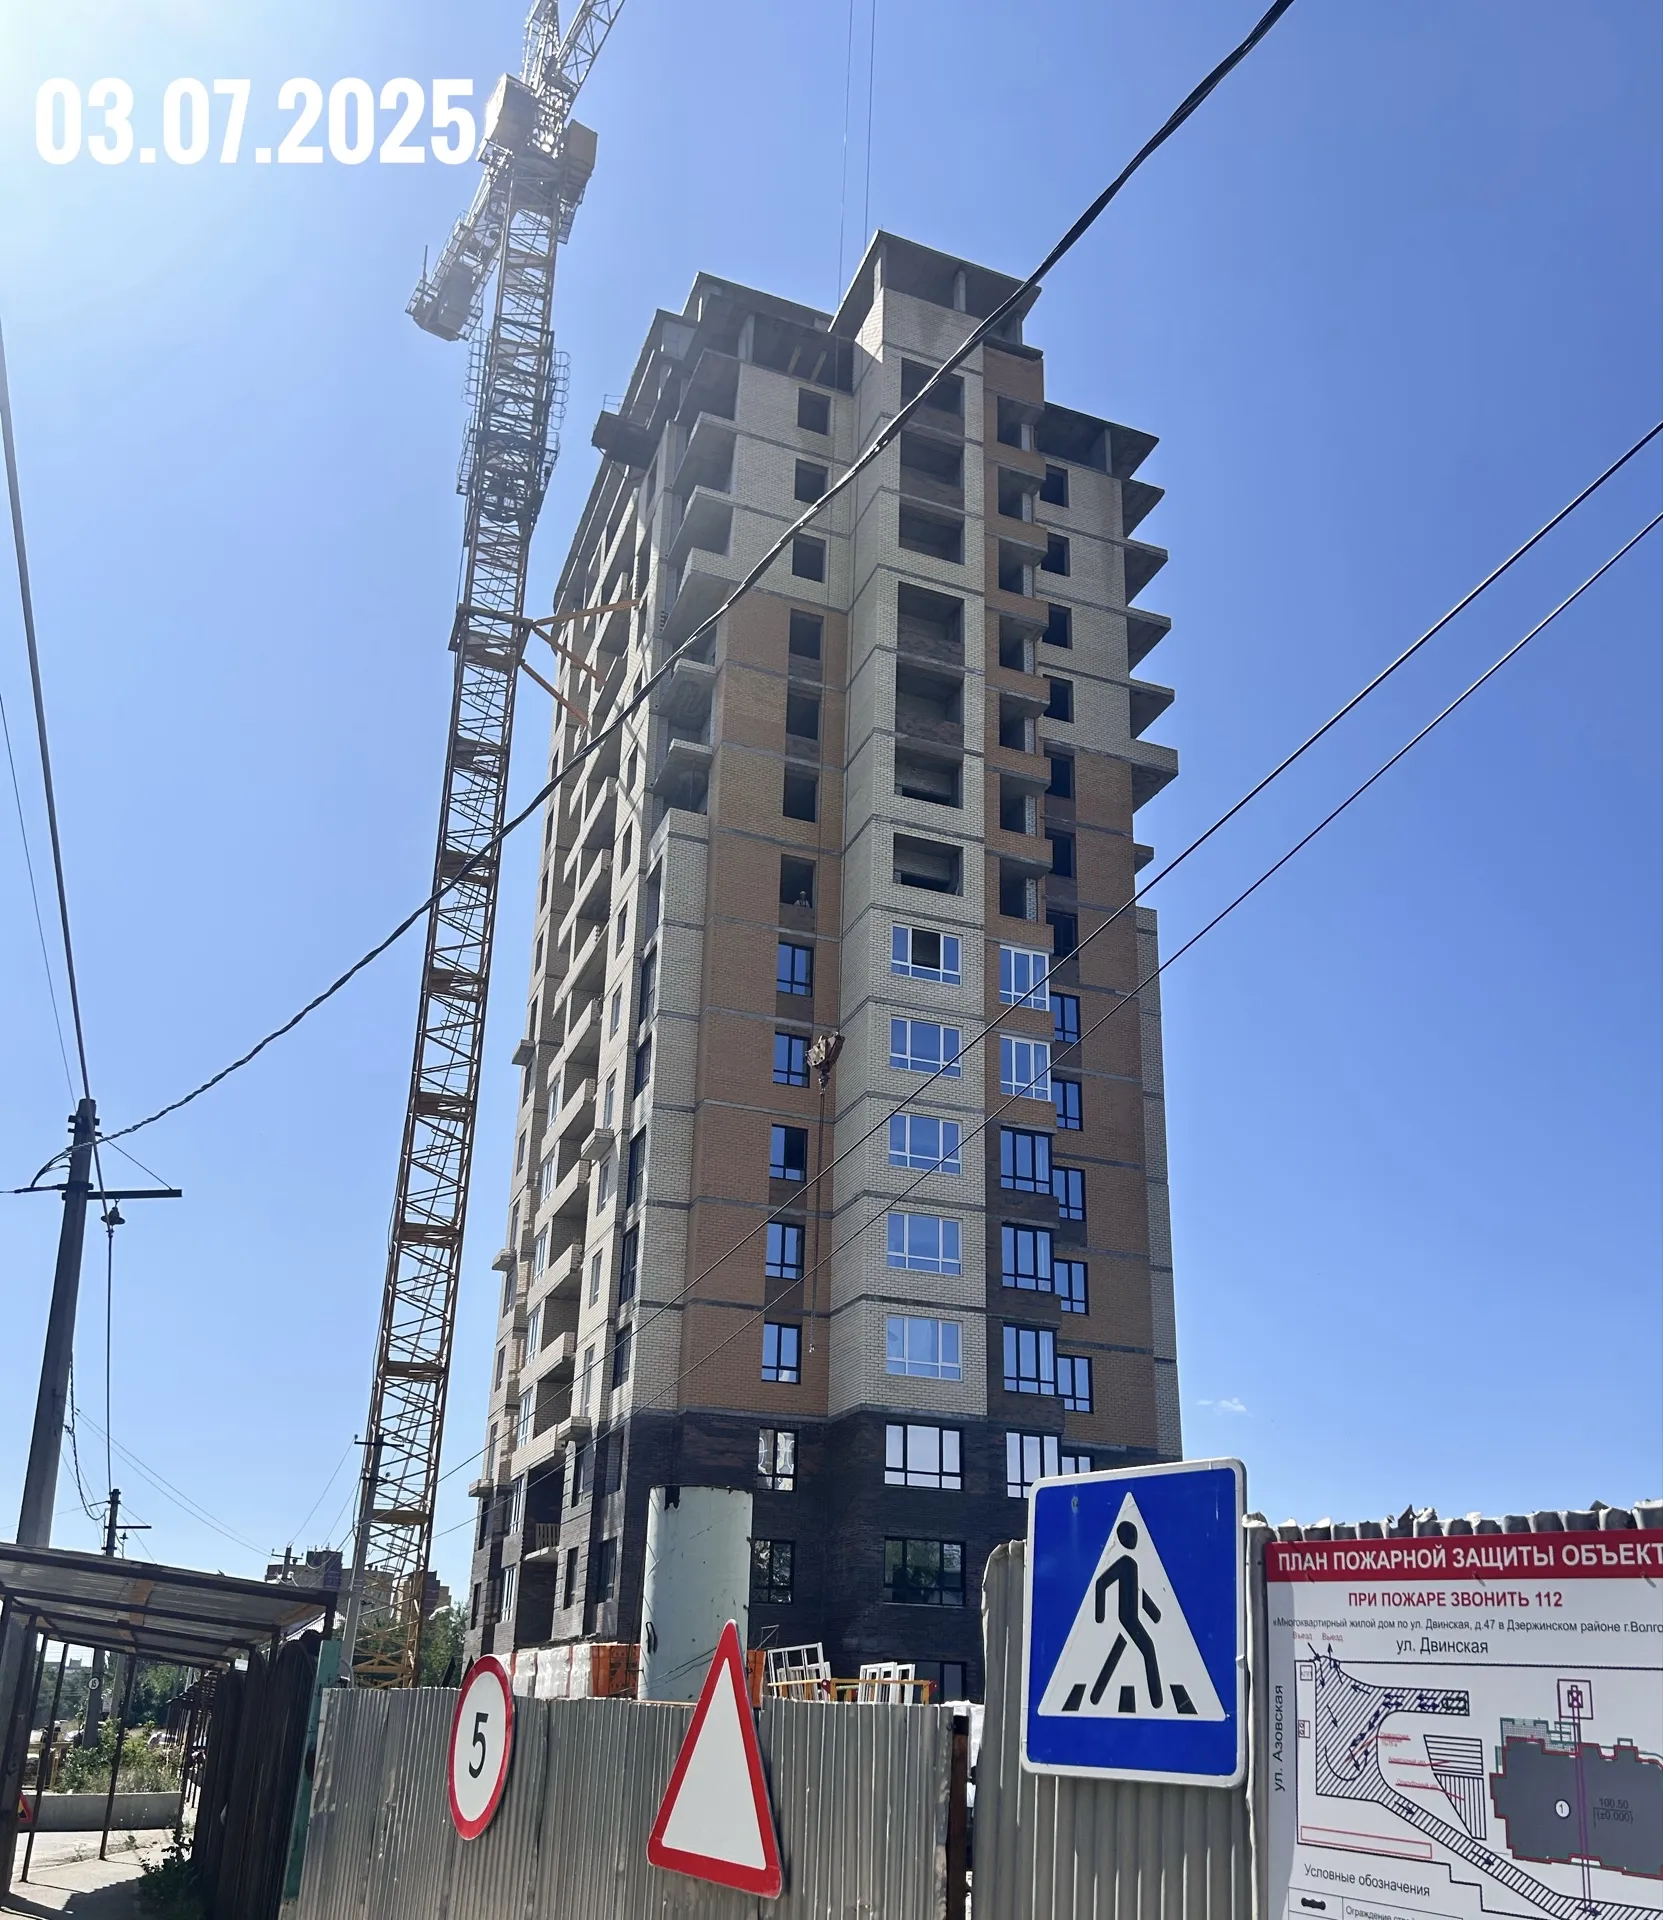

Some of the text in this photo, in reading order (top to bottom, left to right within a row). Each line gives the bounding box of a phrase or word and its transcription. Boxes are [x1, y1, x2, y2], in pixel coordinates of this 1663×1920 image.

[1278, 1543, 1663, 1571] ПЛАН ПОЖАРНОЙ ЗАЩИТЫ ОБЪЕКТ
[1348, 1591, 1563, 1607] ПРИ ПОЖАРЕ ЗВОНИТЬ 112
[1272, 1617, 1347, 1629] «Многоквартирный
[1349, 1618, 1376, 1628] жилой
[1377, 1621, 1395, 1630] дом
[1397, 1621, 1409, 1629] по
[1410, 1621, 1423, 1631] ул.
[1425, 1619, 1472, 1631] Двинская,
[1474, 1619, 1495, 1631] д.47
[1498, 1622, 1504, 1630] в
[1507, 1619, 1577, 1632] Дзержинском
[1580, 1620, 1620, 1633] районе
[1396, 1636, 1489, 1655] ул. Двинская
[468, 1711, 489, 1779] 5
[1272, 1685, 1286, 1792] ул. Азовская
[1304, 1863, 1431, 1897] Условные обозначения
[1346, 1905, 1392, 1920] Ограждение
